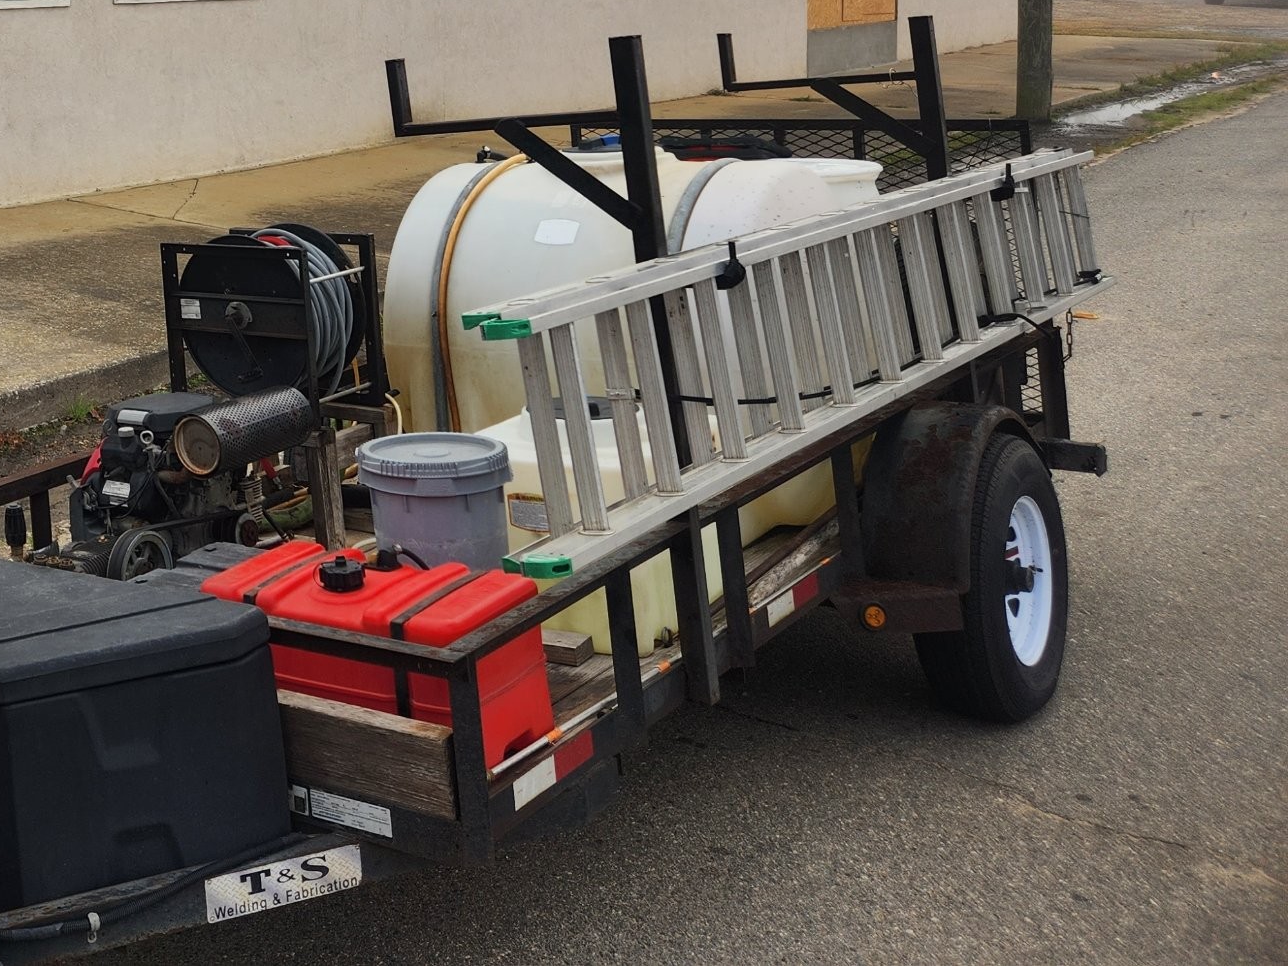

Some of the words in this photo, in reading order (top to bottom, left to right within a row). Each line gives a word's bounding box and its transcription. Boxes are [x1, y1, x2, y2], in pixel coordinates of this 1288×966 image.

[214, 898, 268, 920] Welding
[272, 893, 282, 905] &
[285, 875, 358, 902] Fabrication
